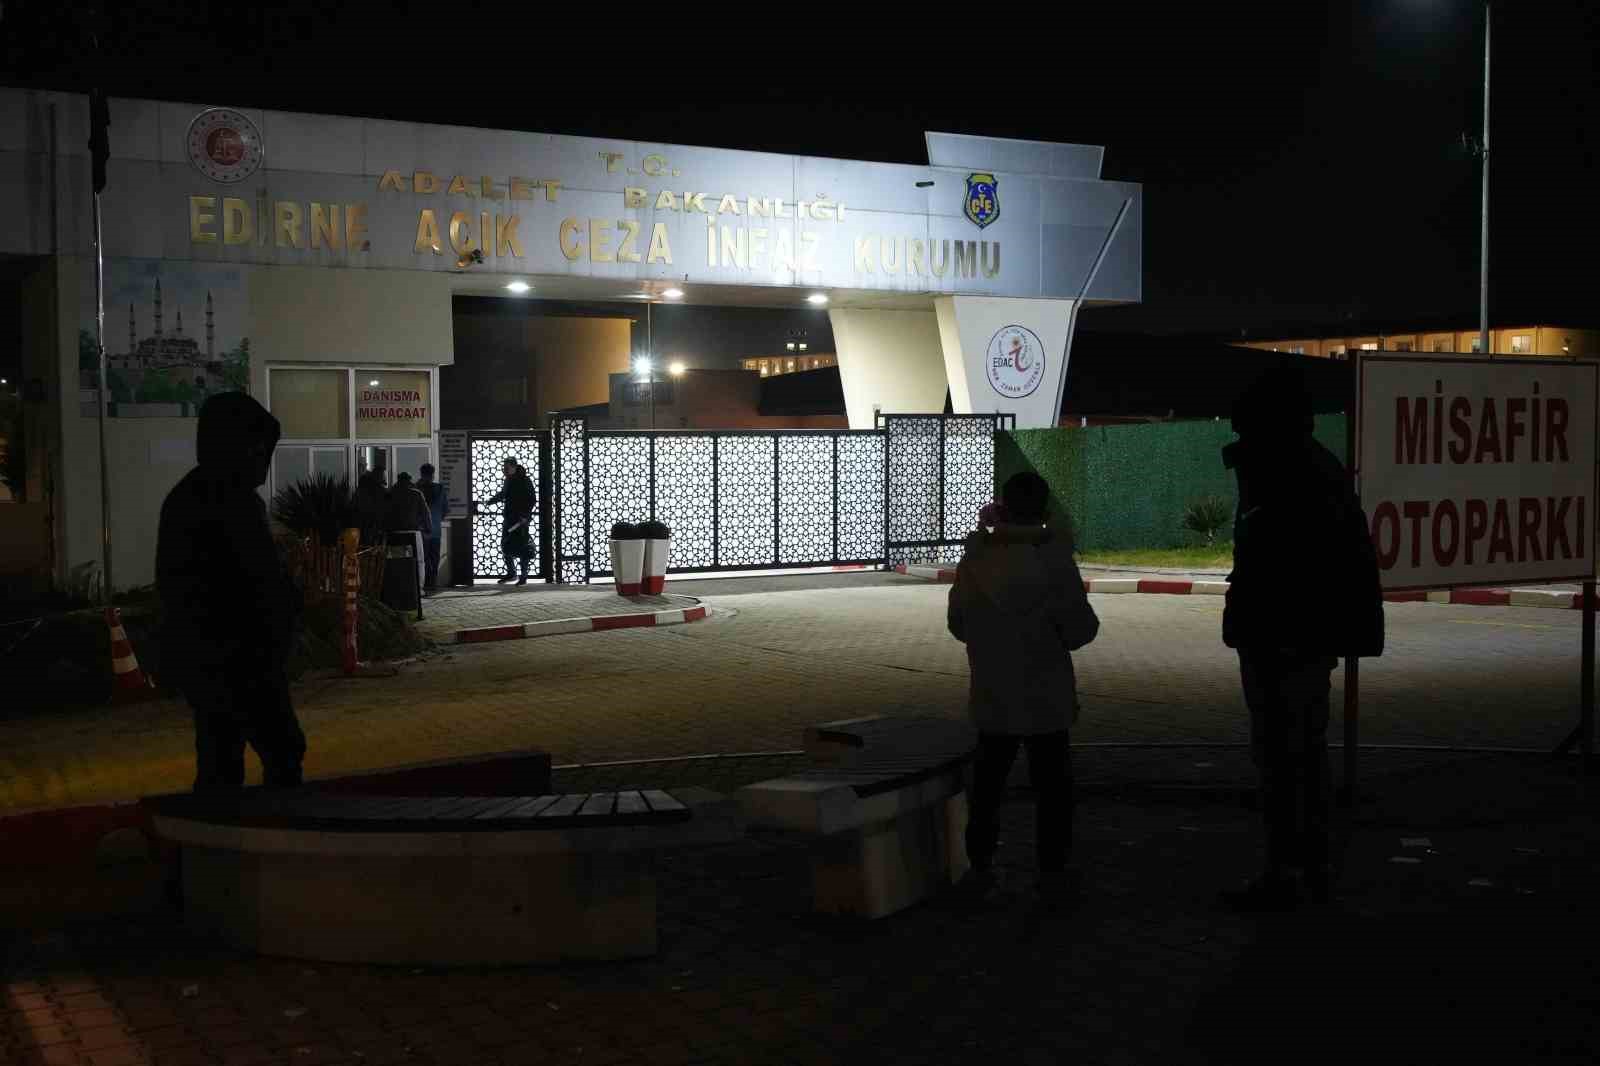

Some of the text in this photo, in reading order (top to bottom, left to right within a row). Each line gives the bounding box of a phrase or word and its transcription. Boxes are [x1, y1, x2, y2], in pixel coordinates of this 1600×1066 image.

[377, 170, 847, 223] ADALET BAKANLIĞI
[189, 189, 1001, 279] EDİRNE AÇIK CEZA İNFAZ KURUMU
[360, 407, 426, 419] MURACAAT
[1395, 379, 1570, 465] MİSAFİR
[1373, 496, 1586, 570] OTOPARKI
